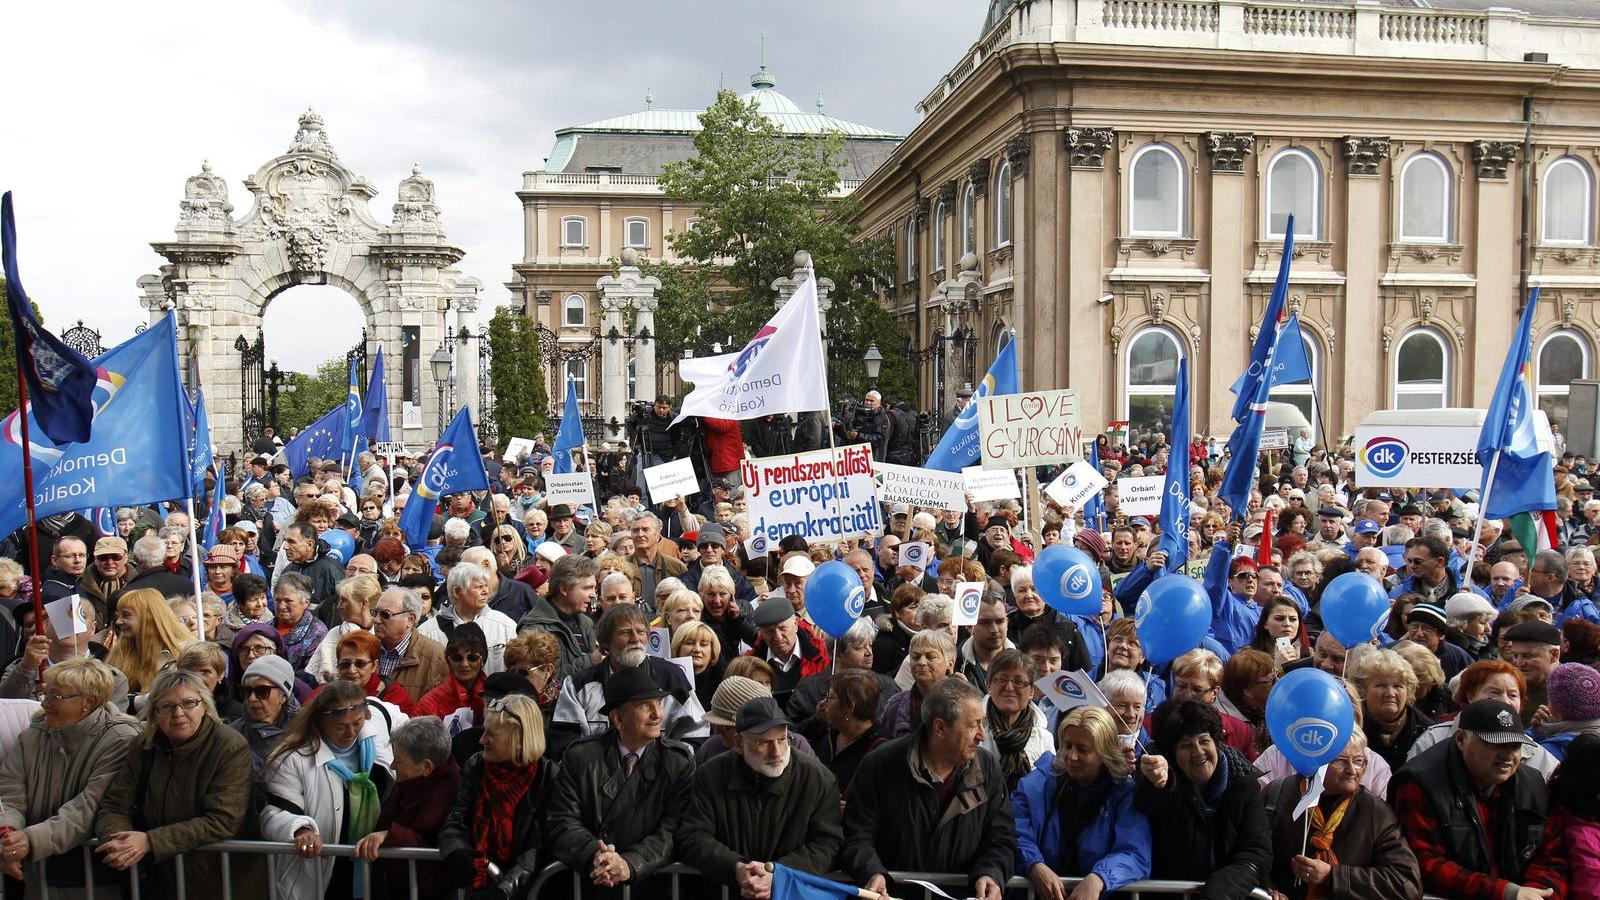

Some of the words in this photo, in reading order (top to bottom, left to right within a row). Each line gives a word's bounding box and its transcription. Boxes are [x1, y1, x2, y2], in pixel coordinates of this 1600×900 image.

[989, 399, 994, 424] I
[377, 442, 404, 454] HATVAN
[986, 423, 1082, 459] GYURCSÁNY
[1373, 448, 1396, 464] dk
[431, 462, 448, 487] dk
[742, 460, 760, 497] Új
[764, 446, 875, 485] rendszerváltást,
[769, 477, 850, 510] európai
[1069, 482, 1095, 504] Kispest
[1130, 484, 1156, 493] Orbán!
[883, 494, 949, 509] BALASSAGYARMAT
[909, 548, 919, 557] dk
[1070, 574, 1086, 591] dk
[965, 596, 977, 608] dk
[1300, 730, 1324, 746] dk
